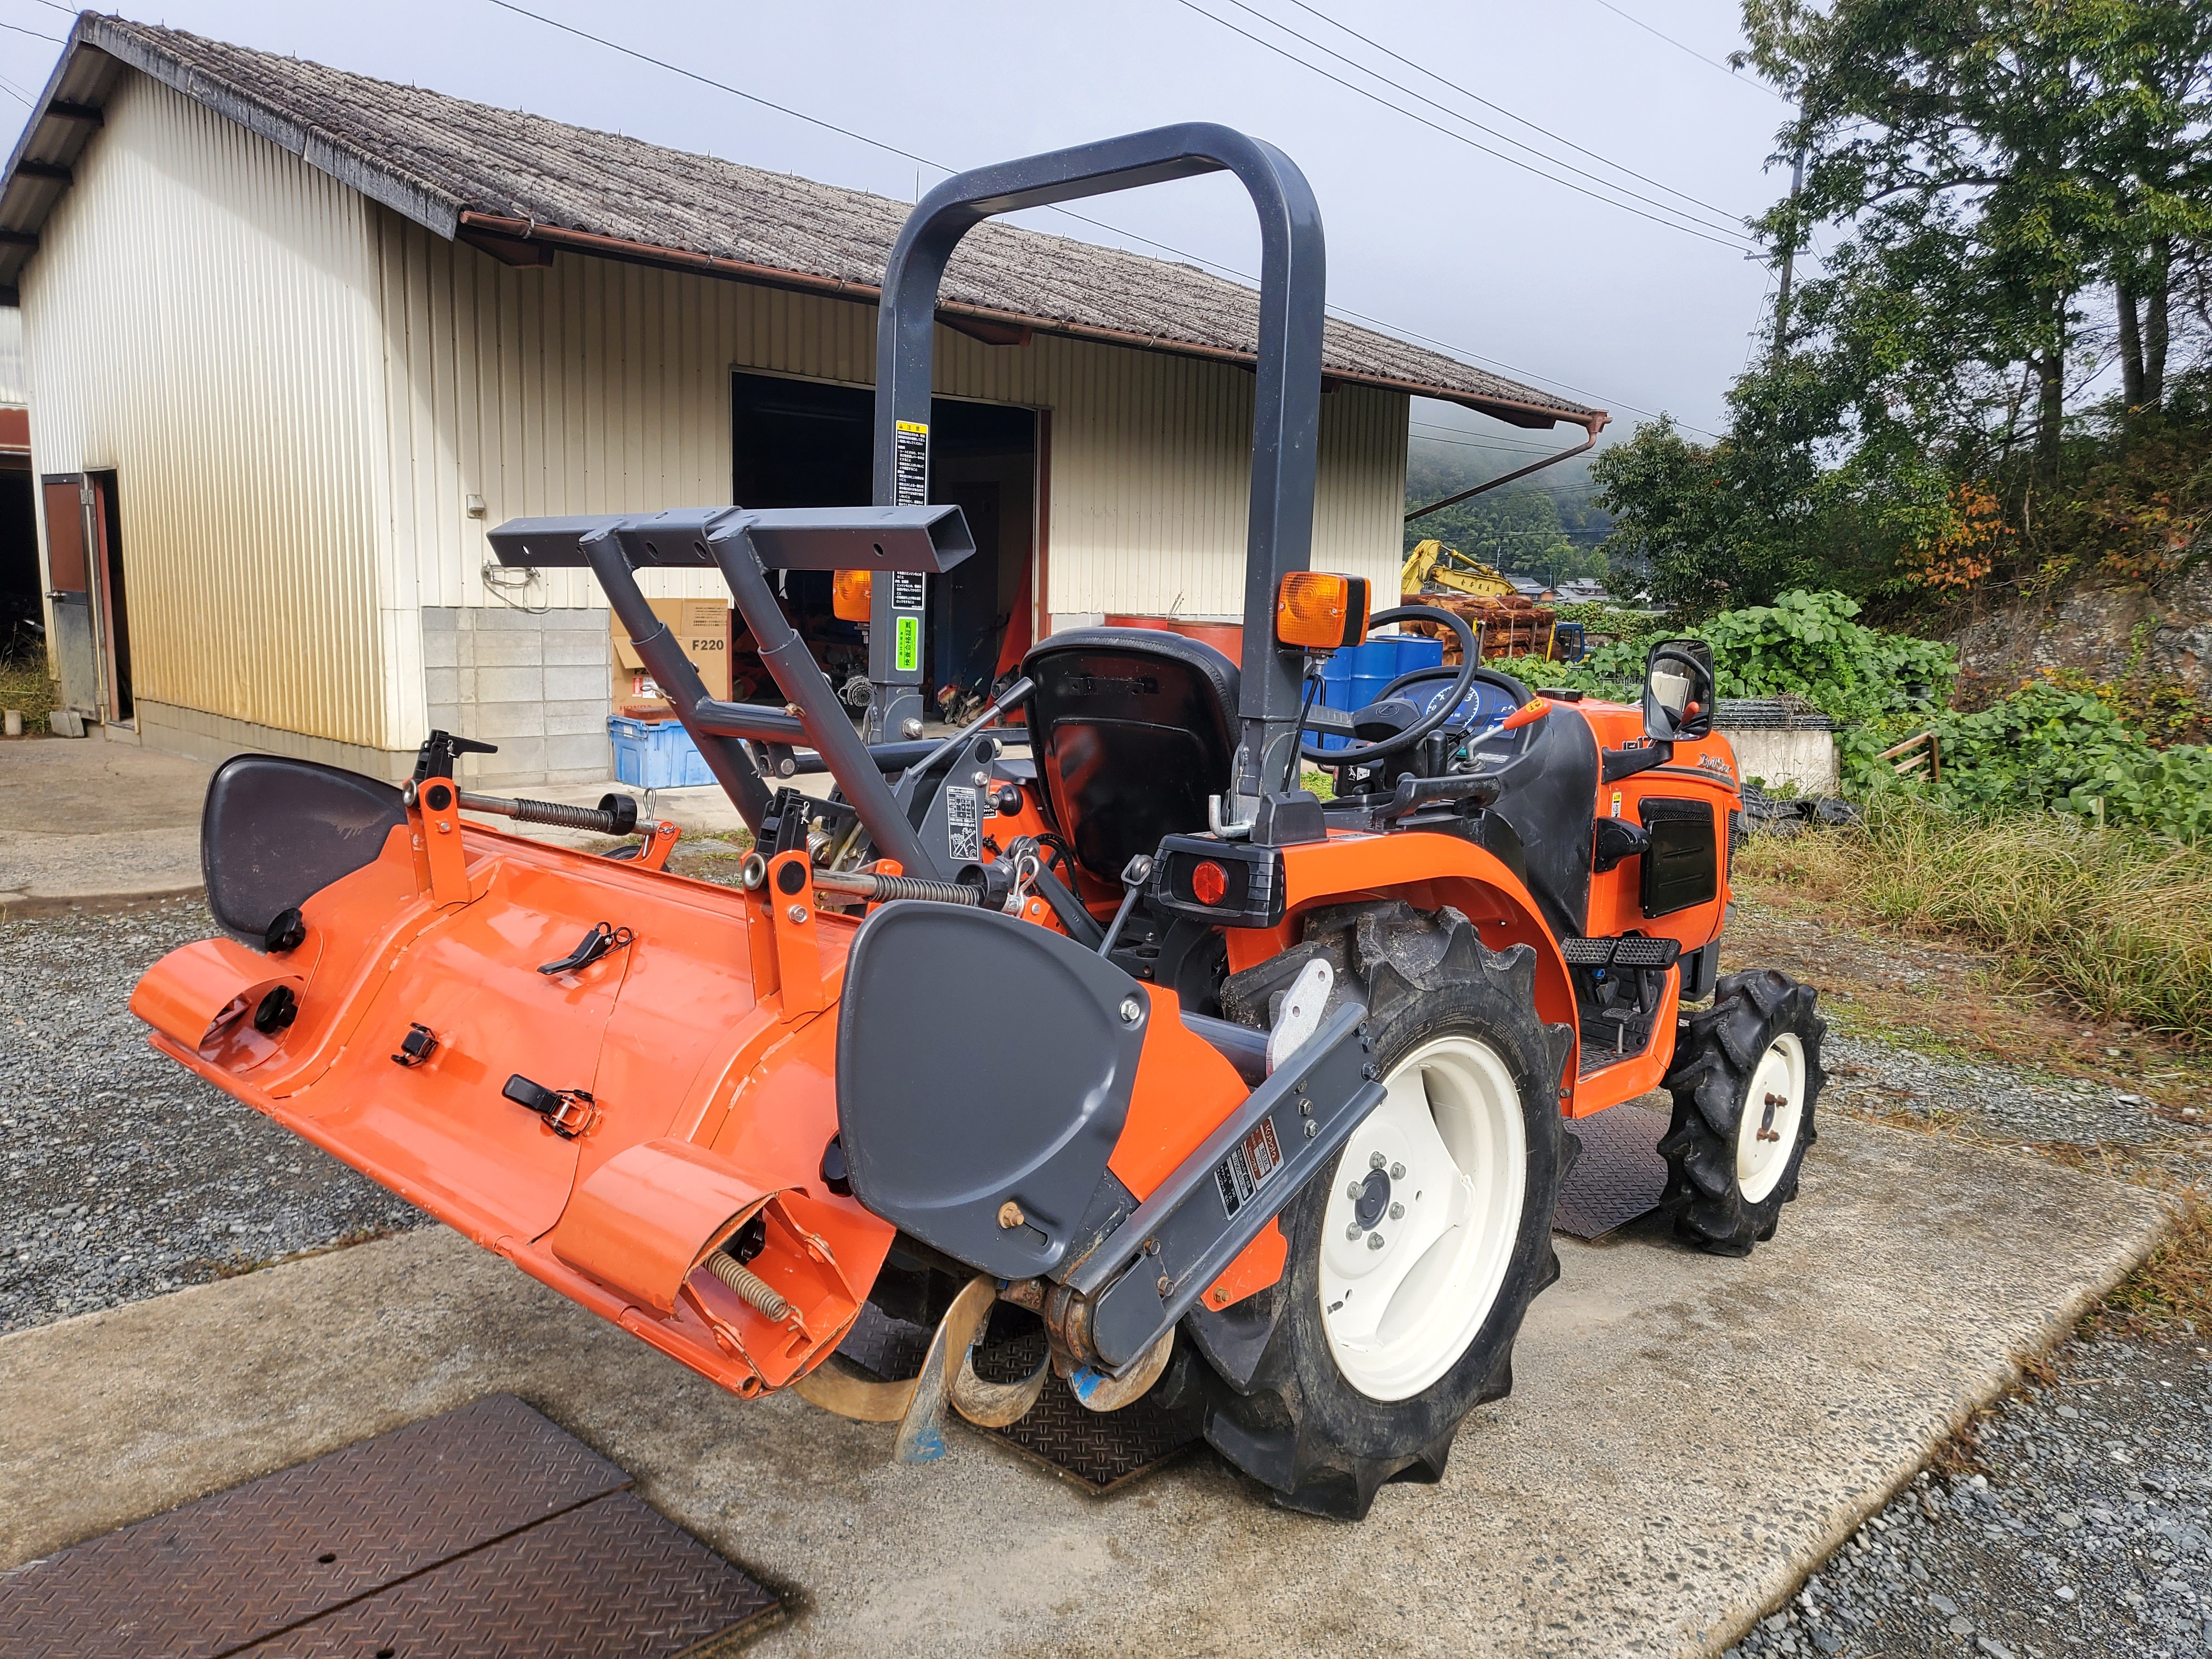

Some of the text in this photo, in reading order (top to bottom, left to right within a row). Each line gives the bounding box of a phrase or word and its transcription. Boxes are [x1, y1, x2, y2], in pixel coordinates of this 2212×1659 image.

[692, 640, 724, 651] F220
[1265, 1124, 1277, 1159] Kubota
[1260, 1147, 1268, 1166] RS13X
